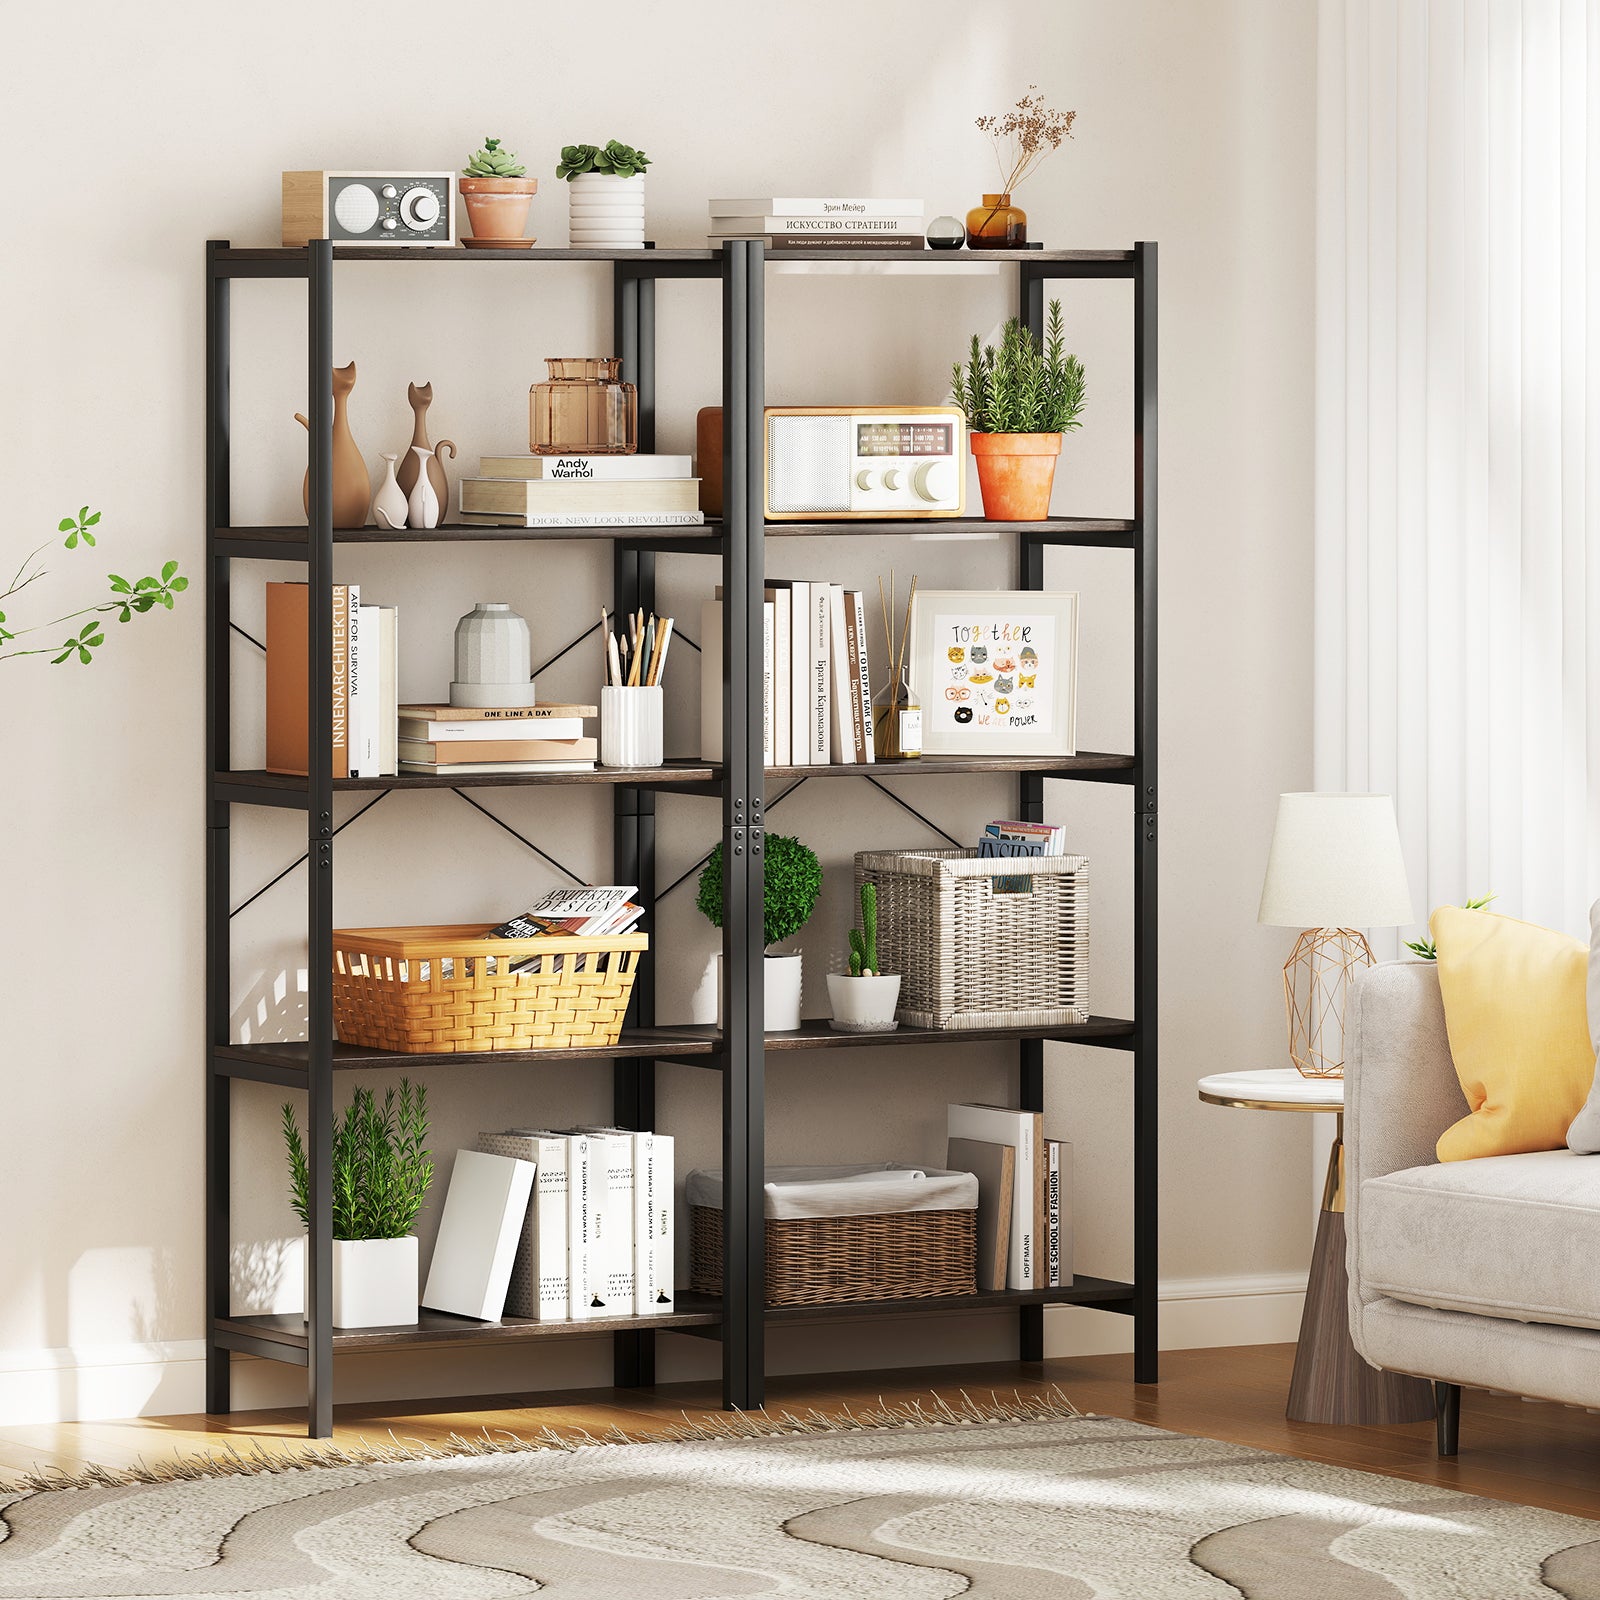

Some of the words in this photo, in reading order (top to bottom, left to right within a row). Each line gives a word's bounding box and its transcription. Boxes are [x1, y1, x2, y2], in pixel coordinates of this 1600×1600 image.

[823, 203, 841, 213] Эрин
[842, 202, 866, 213] Мейер
[786, 220, 843, 230] ИСКУССТВО
[845, 220, 898, 230] СТРАТЕГИИ
[557, 458, 588, 470] Andy
[552, 469, 593, 478] Warhol
[566, 516, 591, 525] NEW
[594, 516, 625, 524] LOOK
[628, 515, 699, 524] REVOLUTION
[333, 585, 345, 748] INNENARCHITEKTUR
[860, 651, 870, 695] ГОВОРИ
[815, 660, 826, 693] Братья
[863, 697, 872, 717] КАК
[815, 695, 826, 752] Карамазовы
[865, 720, 873, 737] БОГ
[854, 723, 863, 752] смерть
[536, 900, 614, 912] DESIGN
[508, 917, 540, 935] domus
[1050, 1170, 1058, 1209] FASHION
[1050, 1210, 1058, 1225] OF
[1050, 1226, 1058, 1263] SCHOOL
